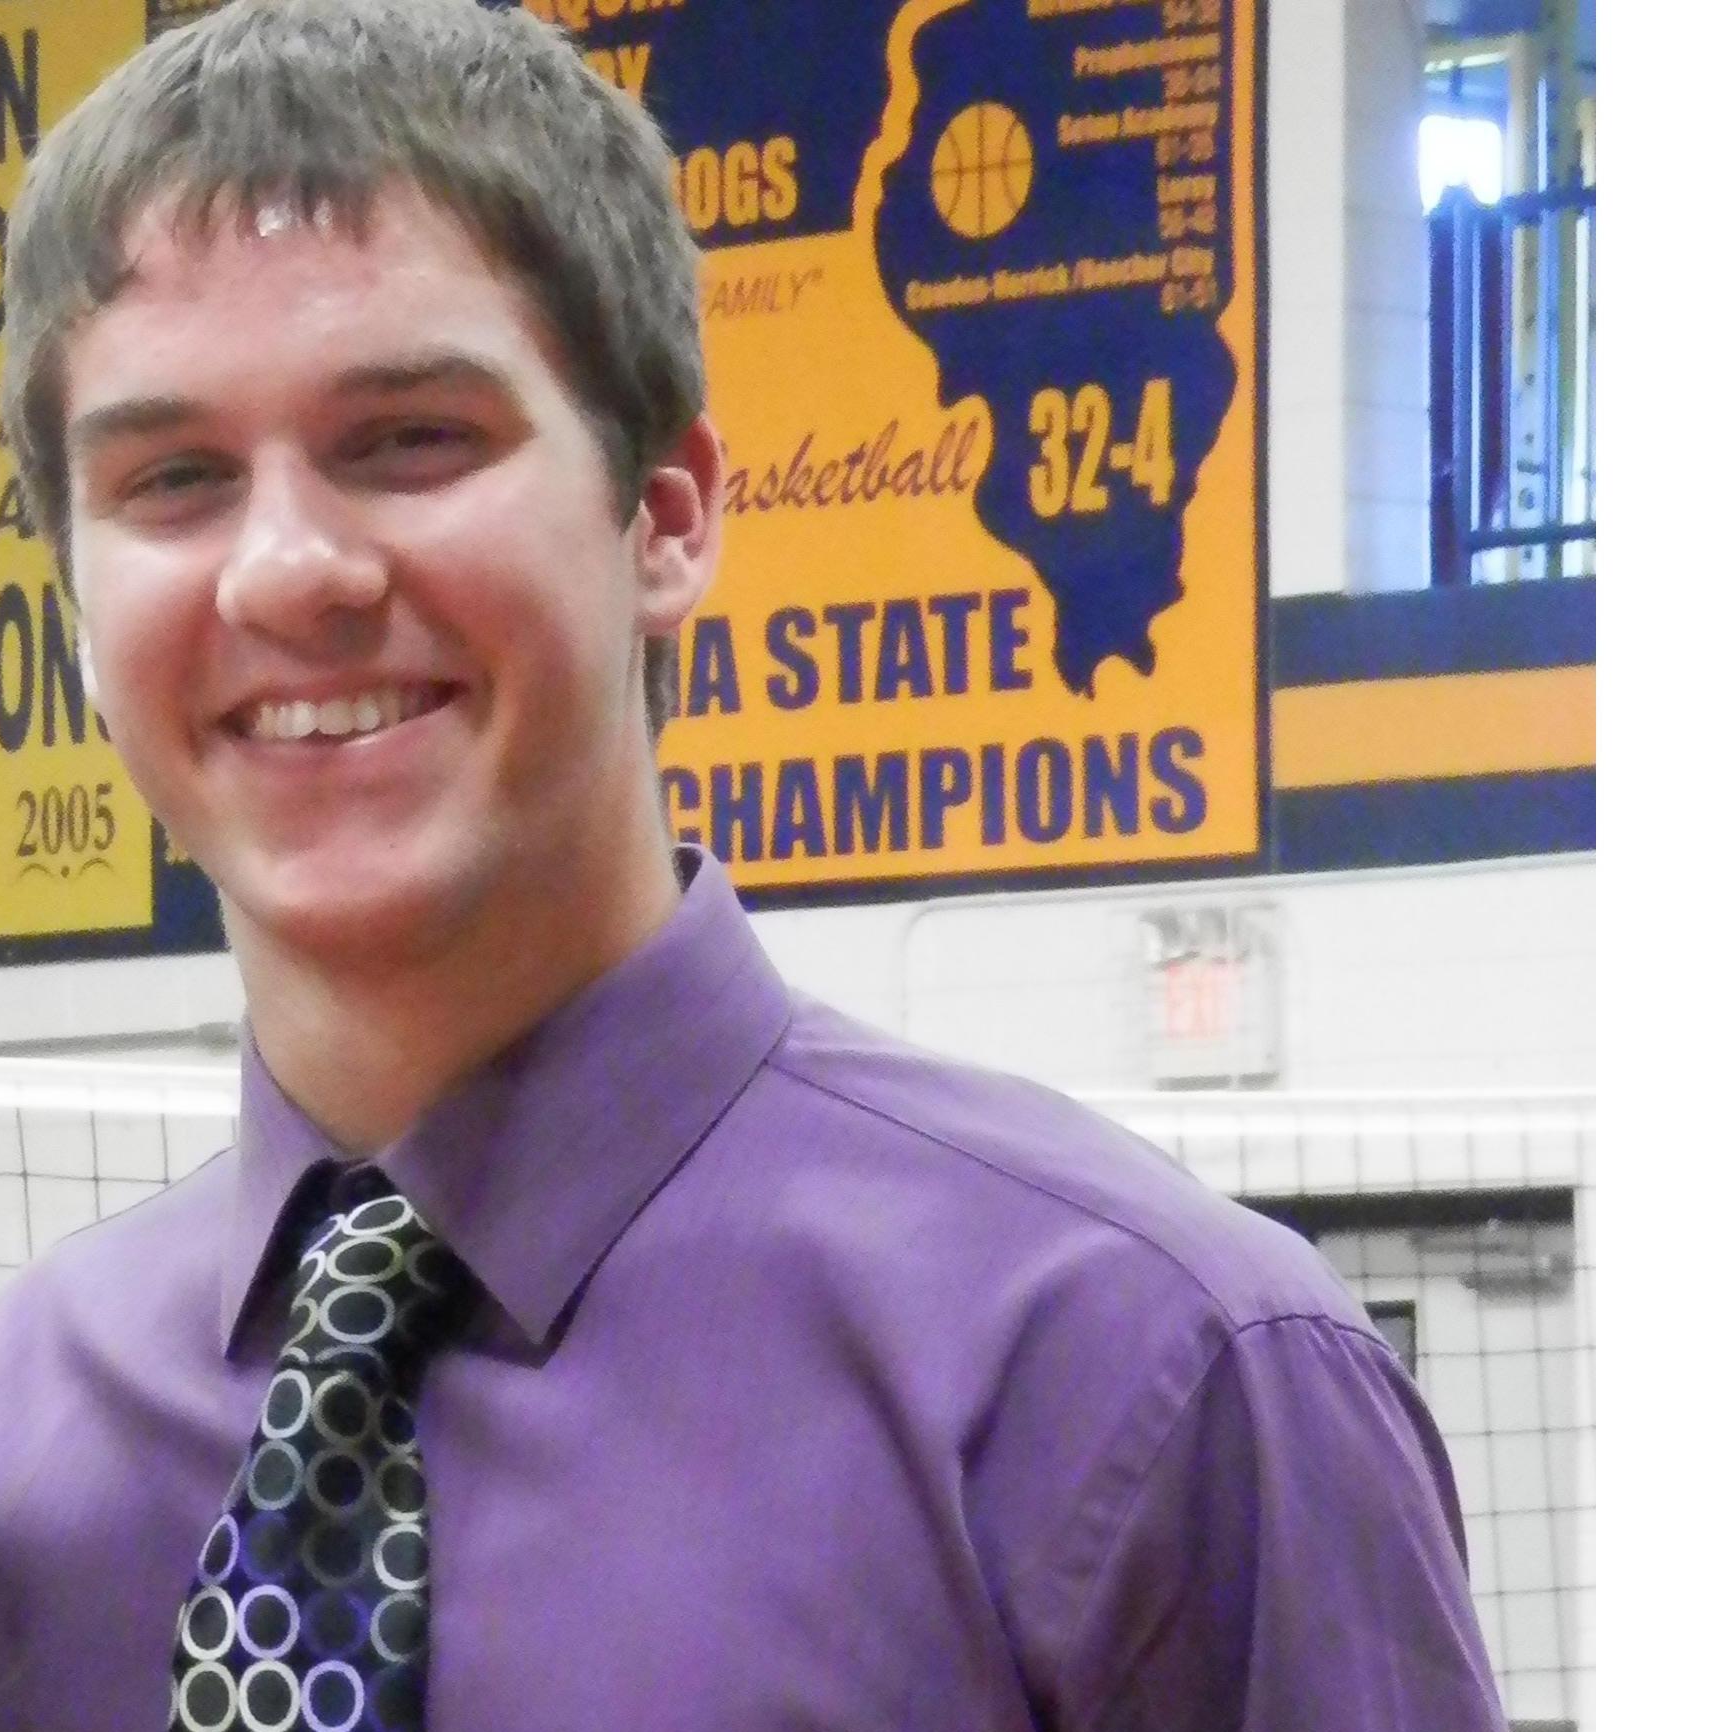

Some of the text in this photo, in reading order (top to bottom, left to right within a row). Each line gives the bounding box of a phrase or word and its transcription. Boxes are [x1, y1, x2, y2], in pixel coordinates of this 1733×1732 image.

[700, 266, 825, 322] AMILY"
[718, 416, 980, 516] asketball
[1028, 377, 1176, 518] 32-4
[765, 586, 1035, 711] STATE
[15, 782, 117, 858] 2005
[658, 726, 1209, 863] CHAMPIONS
